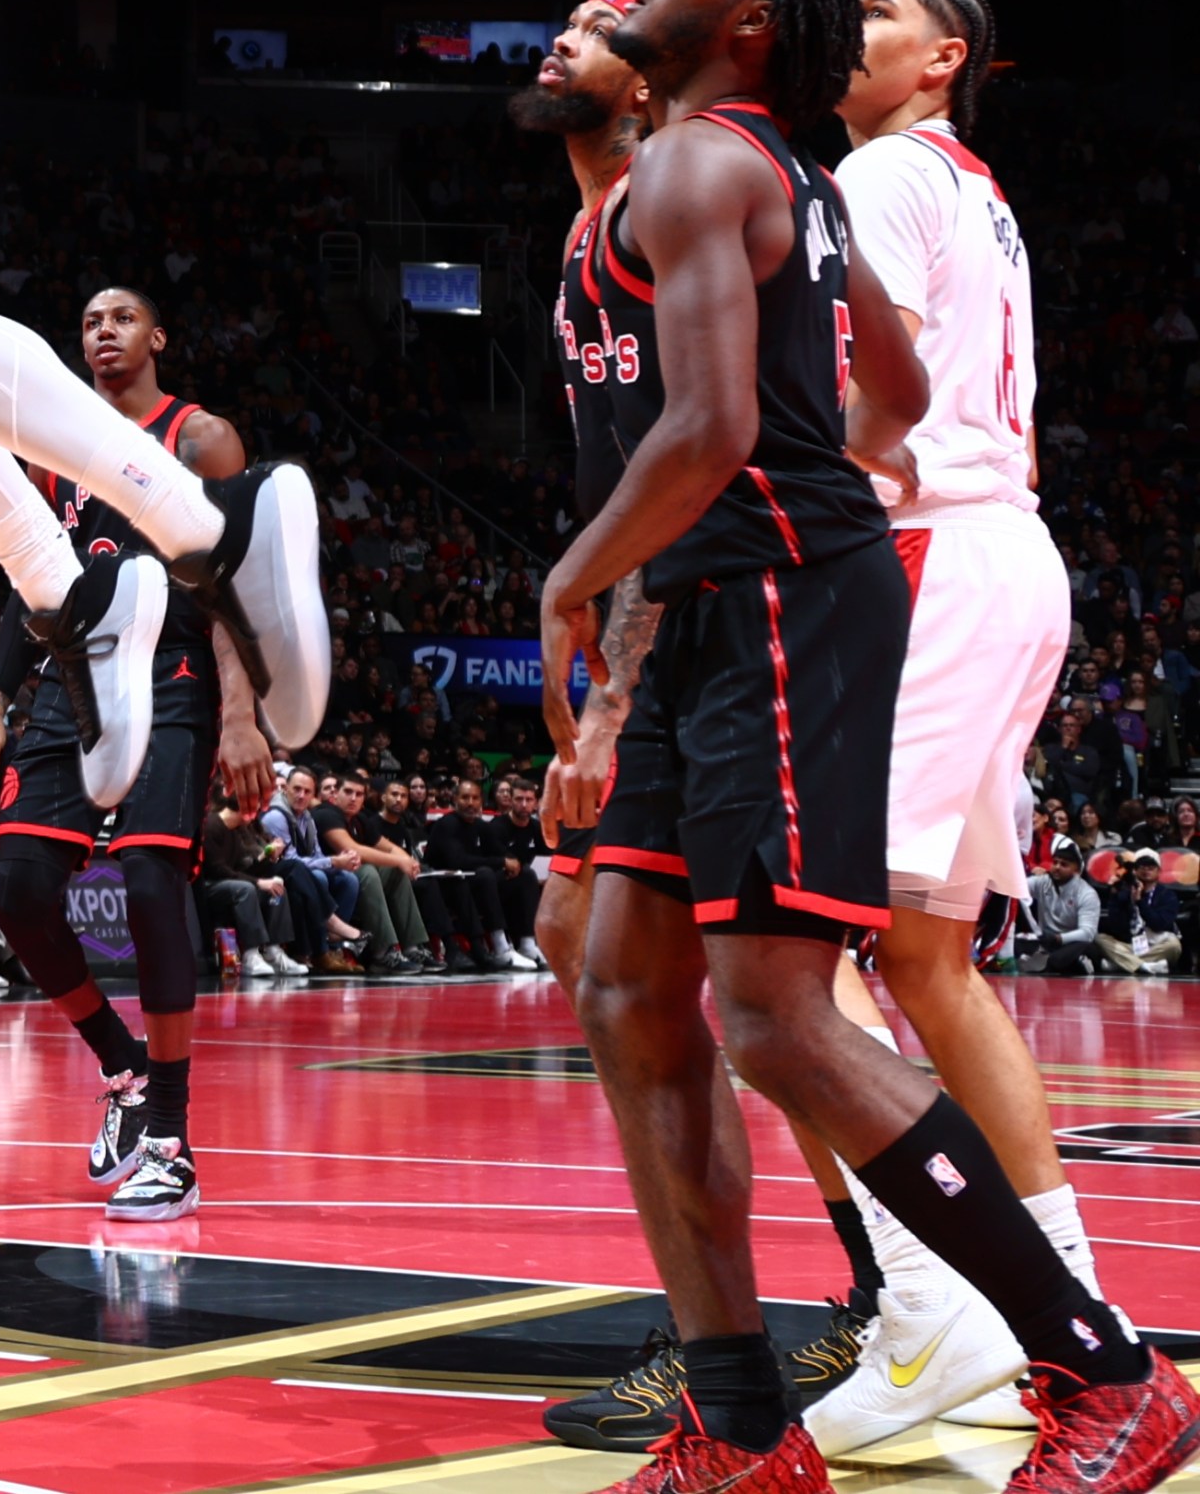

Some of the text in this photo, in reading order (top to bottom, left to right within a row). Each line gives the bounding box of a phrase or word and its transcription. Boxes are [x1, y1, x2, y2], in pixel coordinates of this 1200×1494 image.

[407, 272, 475, 303] IBM
[465, 658, 590, 688] FANDE
[66, 888, 128, 922] KPOT
